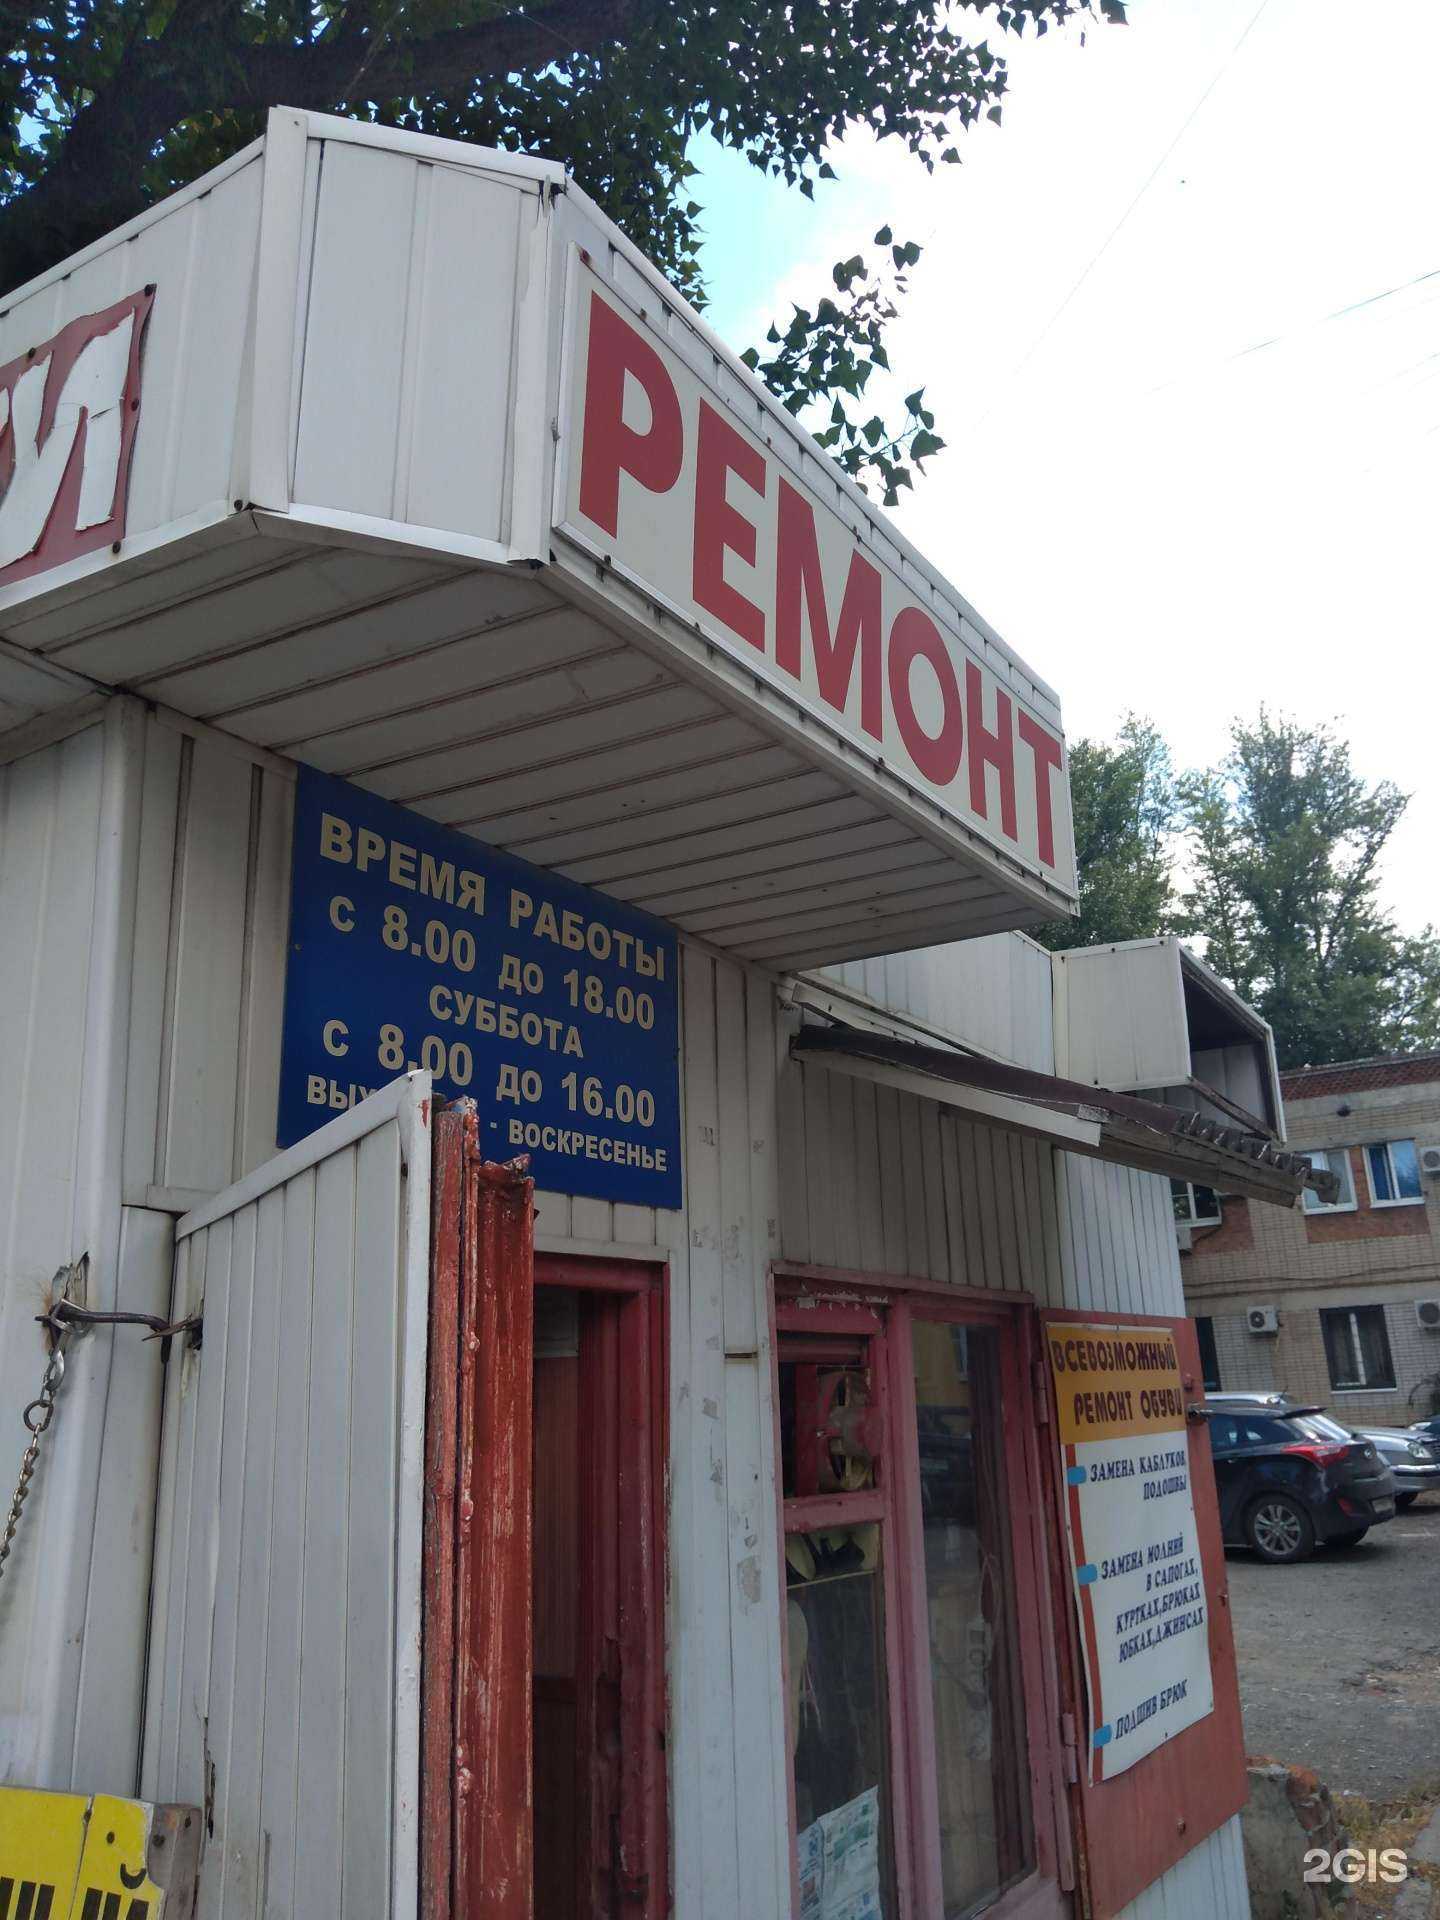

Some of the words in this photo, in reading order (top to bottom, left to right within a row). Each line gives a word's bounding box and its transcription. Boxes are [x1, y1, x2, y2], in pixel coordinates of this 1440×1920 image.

[578, 289, 1063, 870] РЕМОНТ
[320, 812, 487, 916] ВРЕМЯ
[510, 888, 665, 981] РАБОТЫ
[329, 895, 356, 933] С
[383, 904, 476, 973] 8.00
[563, 968, 655, 1031] 18.00
[429, 985, 585, 1059] СУББОТА
[322, 1019, 350, 1057] С
[377, 1023, 473, 1086] 8.00
[561, 1072, 656, 1128] 16.00
[509, 1118, 667, 1172] ВОСКРЕСЕНЬЕ
[1051, 1338, 1177, 1372] ВСЕВОЗМОЖНЫЙ
[1074, 1391, 1133, 1426] РЕМОНТ
[1140, 1387, 1182, 1419] ОБУВИ
[1090, 1459, 1135, 1482] ЗАМЕНА
[1140, 1450, 1185, 1474] КАБЛУКОВ
[1144, 1474, 1187, 1500] ПОДОШВЫ
[1102, 1550, 1143, 1580] ЗАМЕНА
[1147, 1532, 1184, 1564] МОЛНИЙ
[1146, 1574, 1152, 1591] В
[1154, 1558, 1198, 1587] САПОГАХ,
[1115, 1695, 1158, 1739] ПОДШИВ
[1160, 1679, 1188, 1710] БРЮК
